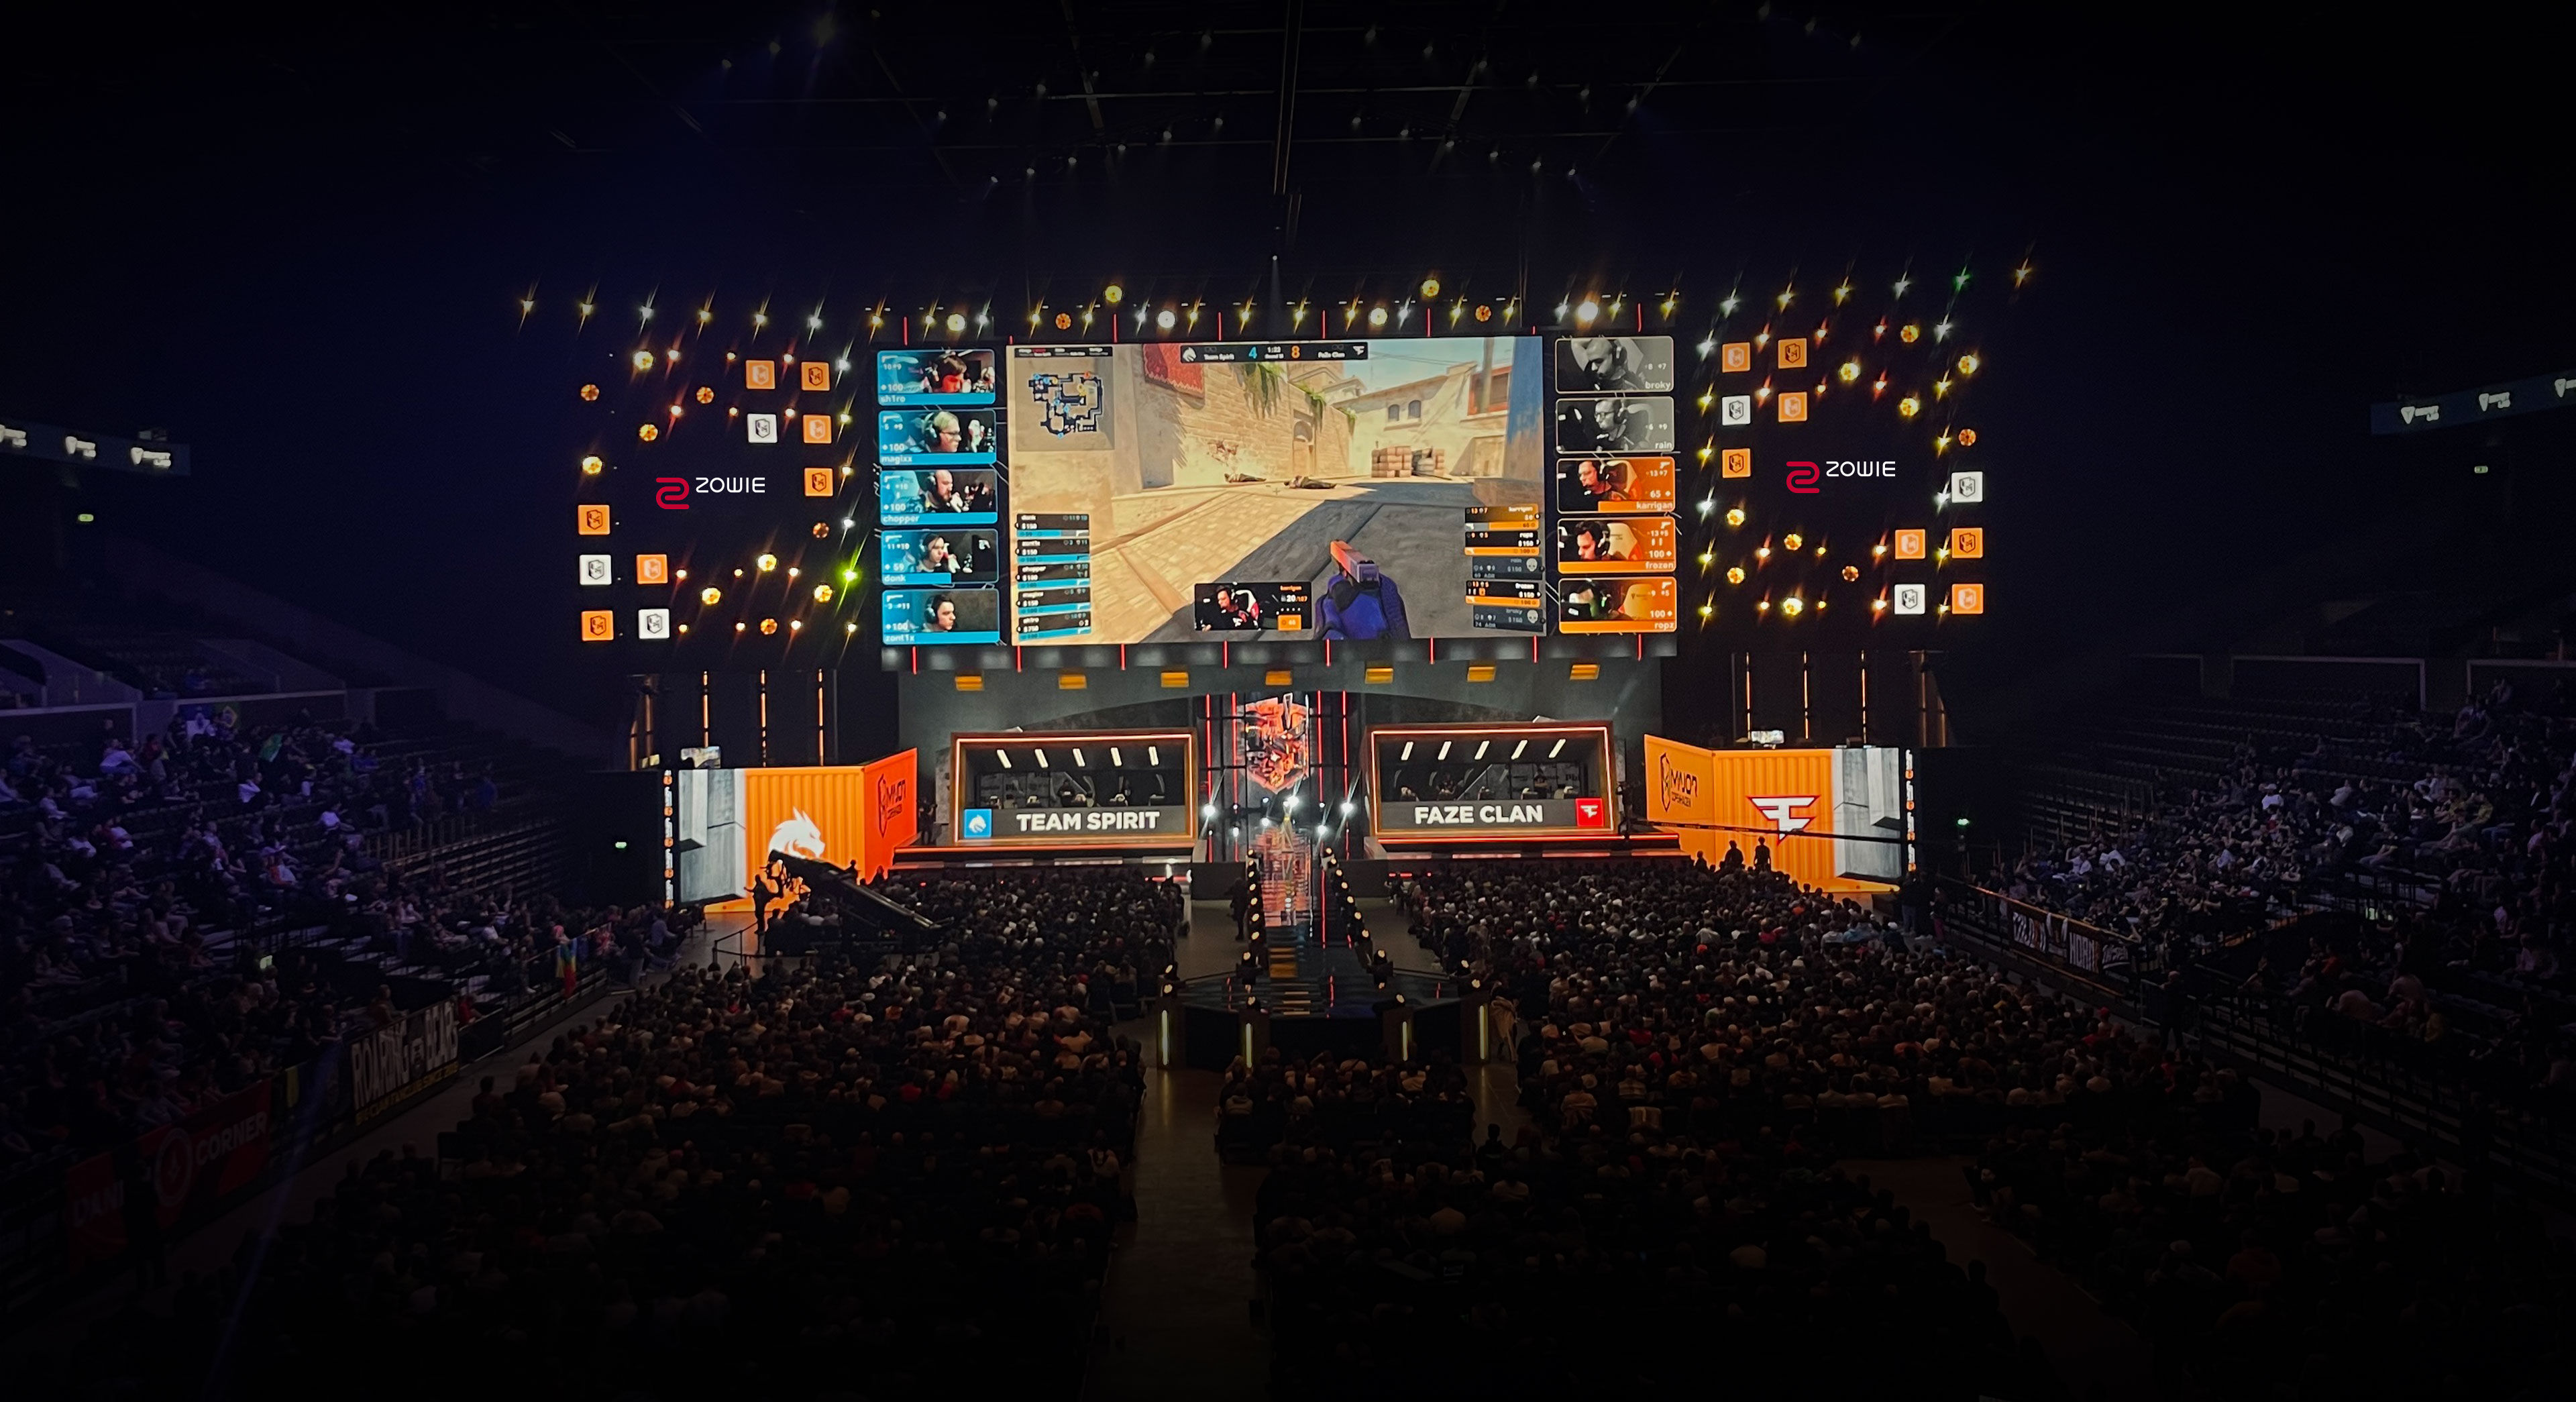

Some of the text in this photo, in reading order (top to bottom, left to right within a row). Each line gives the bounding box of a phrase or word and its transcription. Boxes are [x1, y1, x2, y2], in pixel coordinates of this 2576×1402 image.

[1248, 346, 1258, 359] 4
[1291, 345, 1301, 359] 8
[1644, 380, 1671, 390] broky
[881, 455, 912, 465] magixx
[890, 503, 906, 511] 100
[1636, 501, 1673, 512] karrigan
[883, 515, 920, 523] chopper
[1649, 550, 1665, 558] 100
[1645, 561, 1674, 570] frozen
[884, 574, 906, 582] donk
[1650, 610, 1666, 618] 100
[1654, 621, 1674, 631] ropz
[885, 633, 915, 642] zont1x
[1670, 767, 1698, 798] MAJOR
[1414, 804, 1544, 824] FAZE CLAN
[1016, 810, 1160, 832] TEAM SPIRIT
[195, 1110, 268, 1166] CORNER
